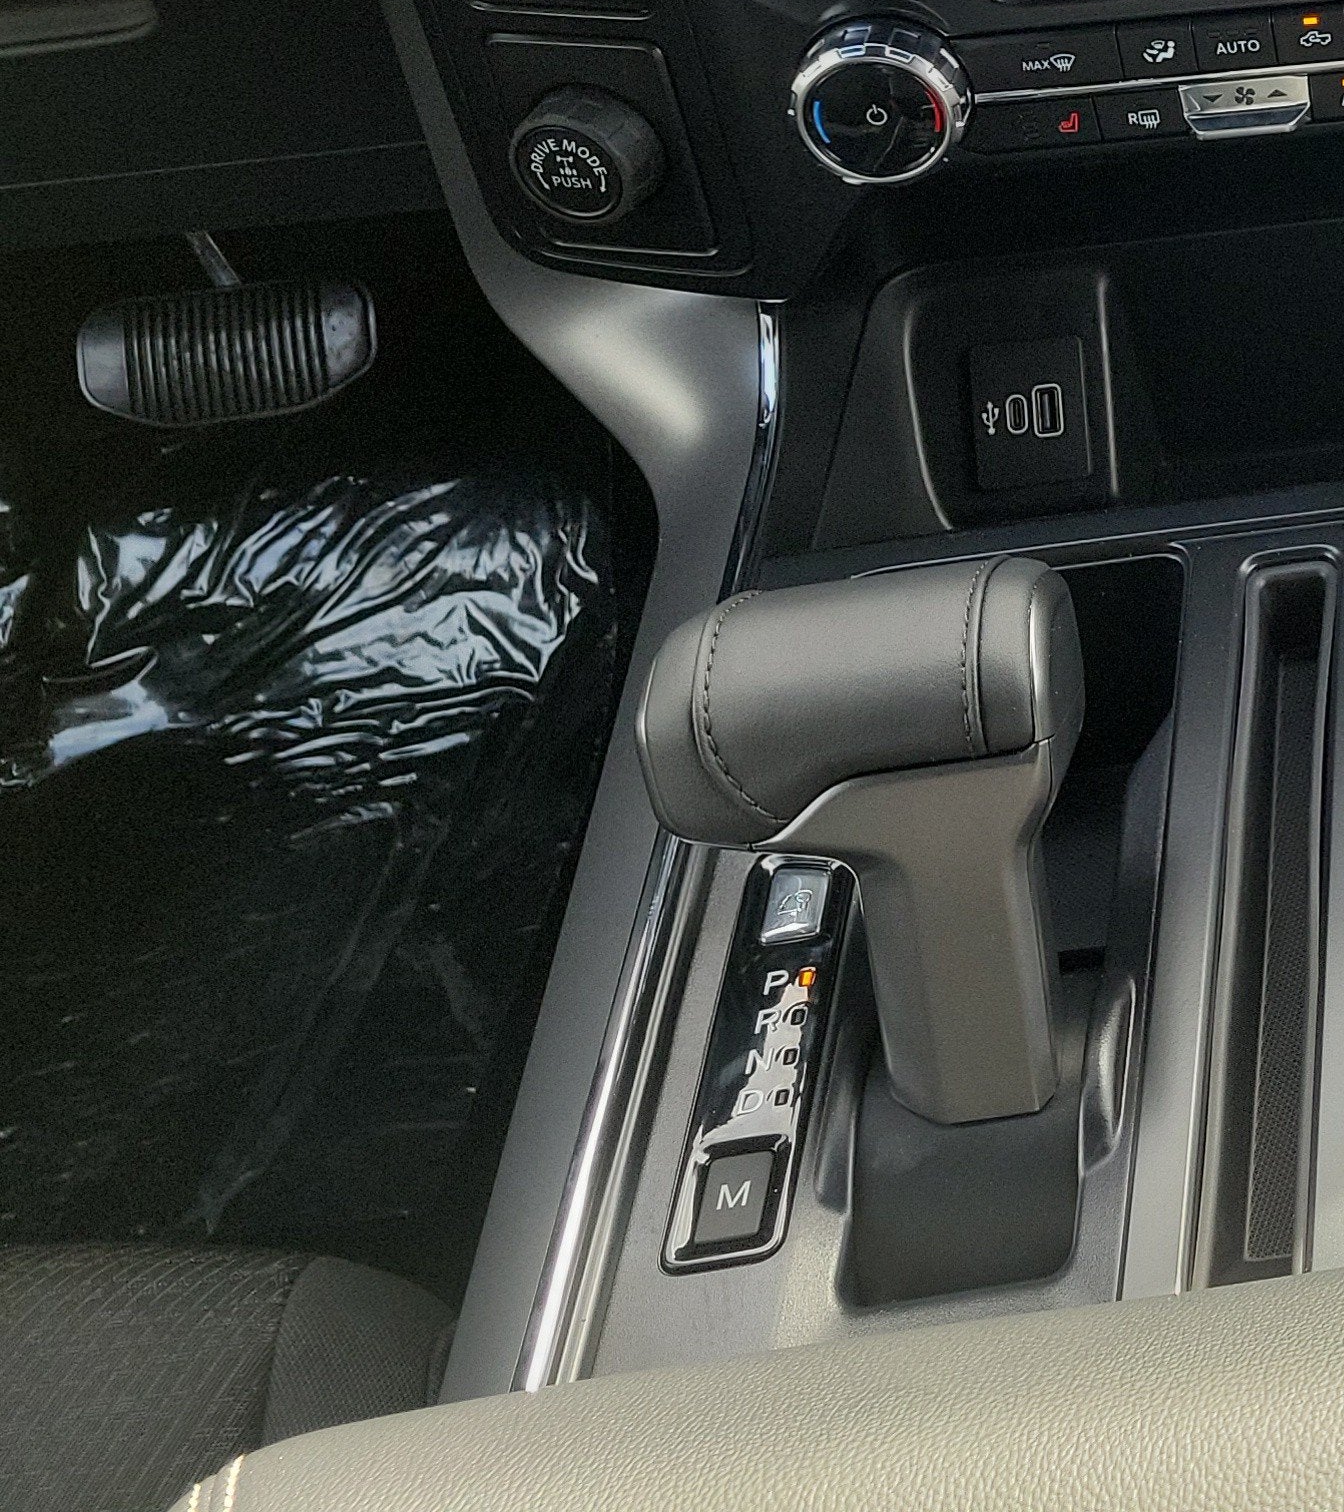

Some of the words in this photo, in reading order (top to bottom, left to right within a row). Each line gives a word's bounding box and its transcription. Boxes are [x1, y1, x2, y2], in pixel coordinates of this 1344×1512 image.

[1216, 39, 1260, 55] AUTO
[1022, 59, 1049, 72] MAX
[1128, 112, 1138, 126] R
[530, 138, 560, 173] DRIVE
[562, 139, 607, 176] MODE
[550, 175, 593, 189] PUSH
[763, 969, 790, 996] P
[754, 1008, 782, 1035] R
[744, 1048, 773, 1075] N
[735, 1089, 765, 1116] D
[716, 1179, 750, 1211] M
